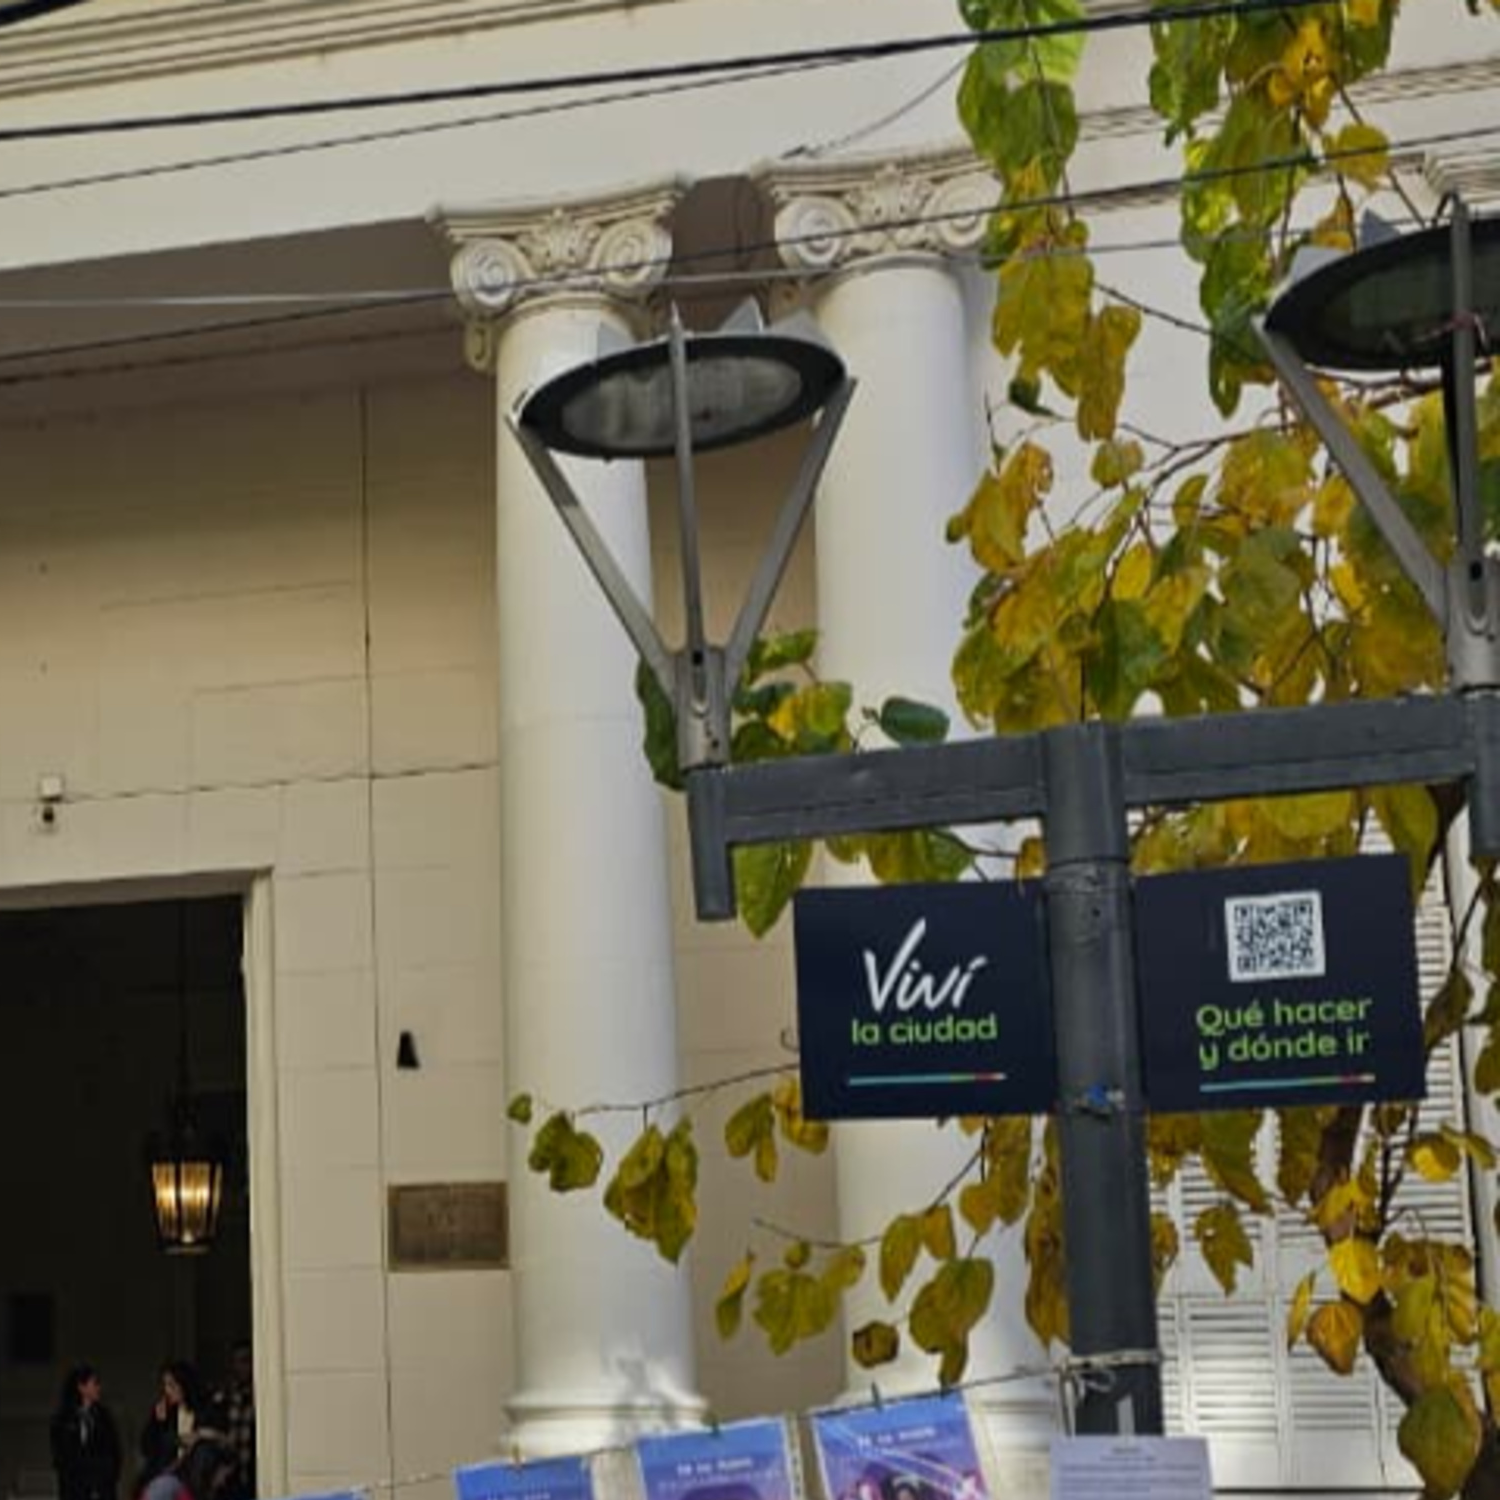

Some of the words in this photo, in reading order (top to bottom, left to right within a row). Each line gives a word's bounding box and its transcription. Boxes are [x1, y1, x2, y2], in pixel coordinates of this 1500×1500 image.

[864, 918, 987, 1013] Viví
[851, 1018, 880, 1046] la
[888, 1014, 998, 1045] ciudad
[1196, 1001, 1265, 1035] Qué
[1275, 997, 1372, 1025] hacer
[1199, 1041, 1220, 1071] y
[1229, 1030, 1336, 1061] dónde
[1348, 1025, 1371, 1053] ir
